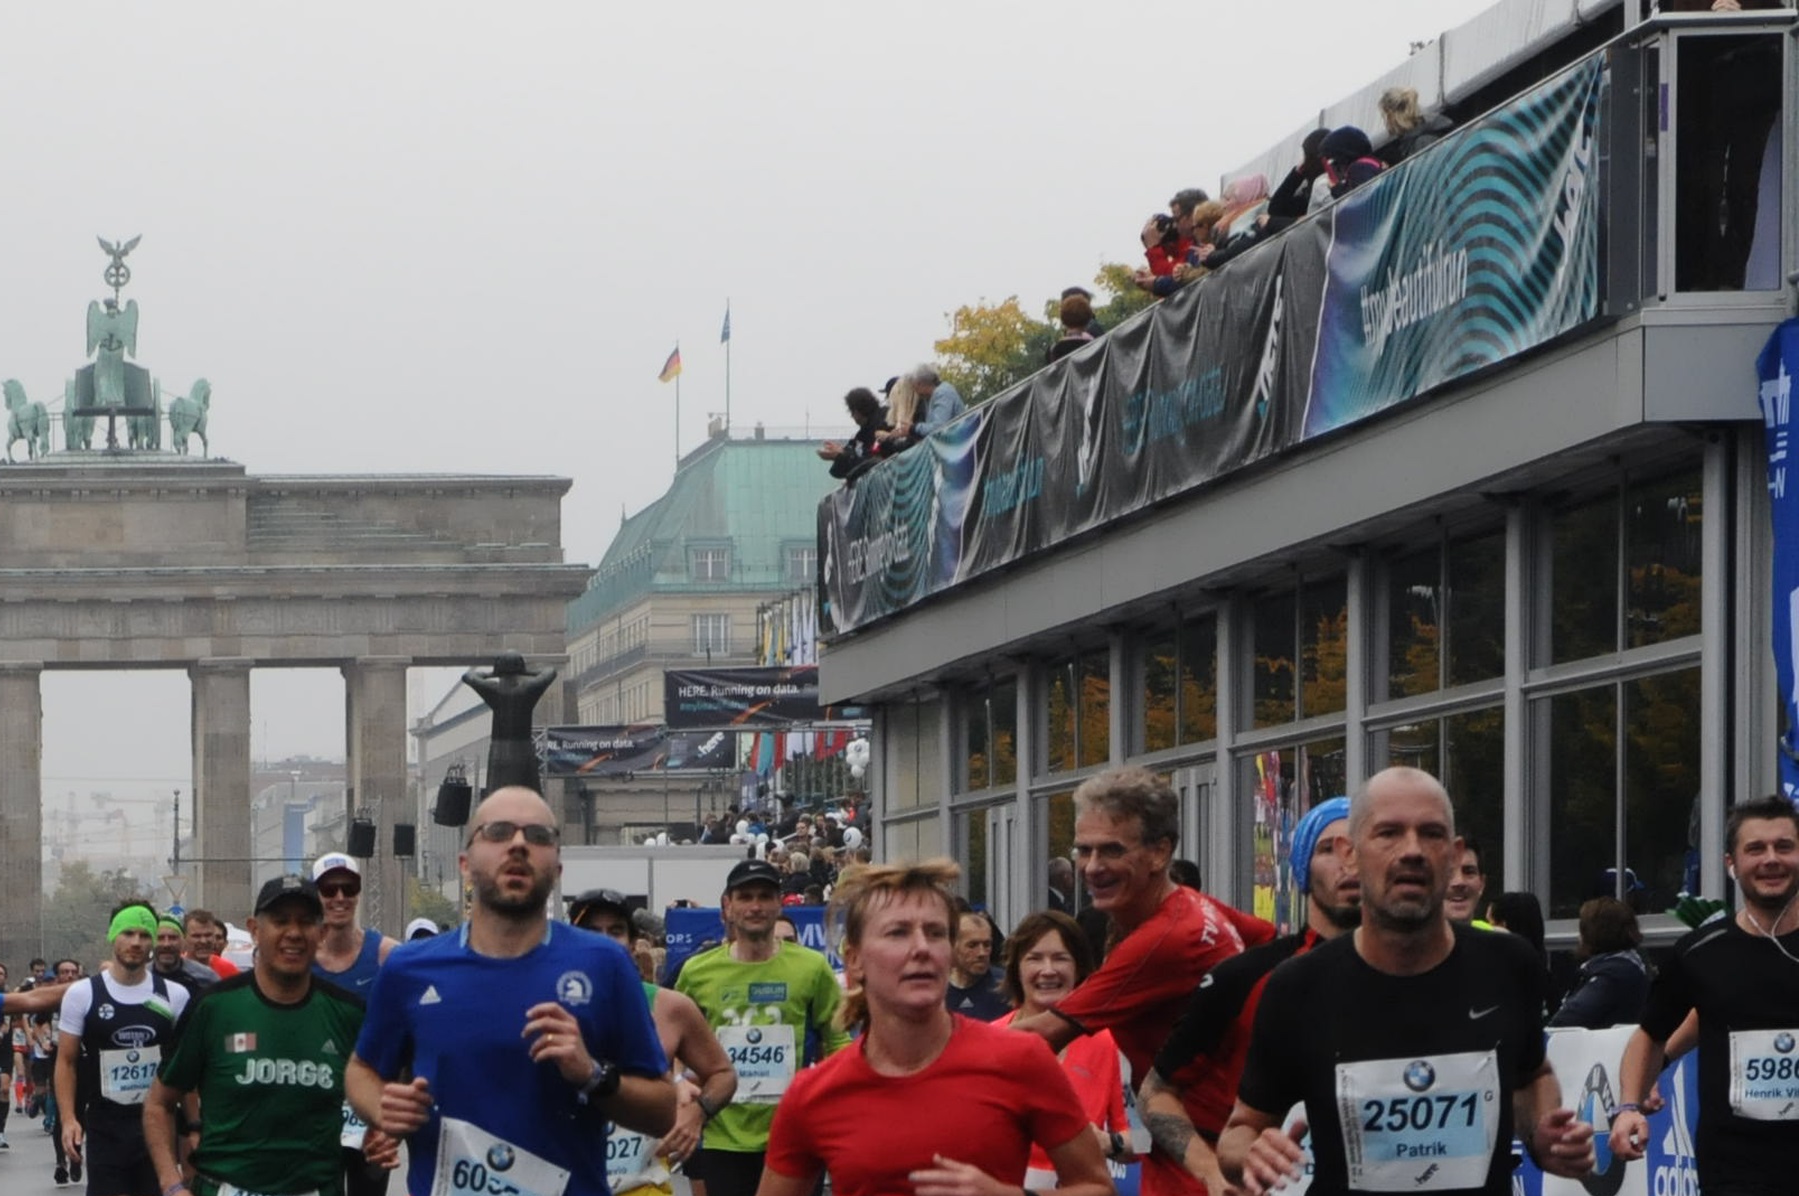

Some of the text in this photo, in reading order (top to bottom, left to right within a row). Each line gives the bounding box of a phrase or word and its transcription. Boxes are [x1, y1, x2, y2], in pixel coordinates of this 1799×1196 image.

[678, 682, 800, 698] HERE. Running on data.
[562, 740, 598, 752] Running
[599, 741, 611, 750] on
[728, 1046, 785, 1065] 34546
[111, 1062, 158, 1081] 12617
[235, 1057, 335, 1090] JORGE
[1744, 1087, 1783, 1099] Henrik
[1363, 1092, 1480, 1133] 25071
[1395, 1141, 1447, 1158] Patrik
